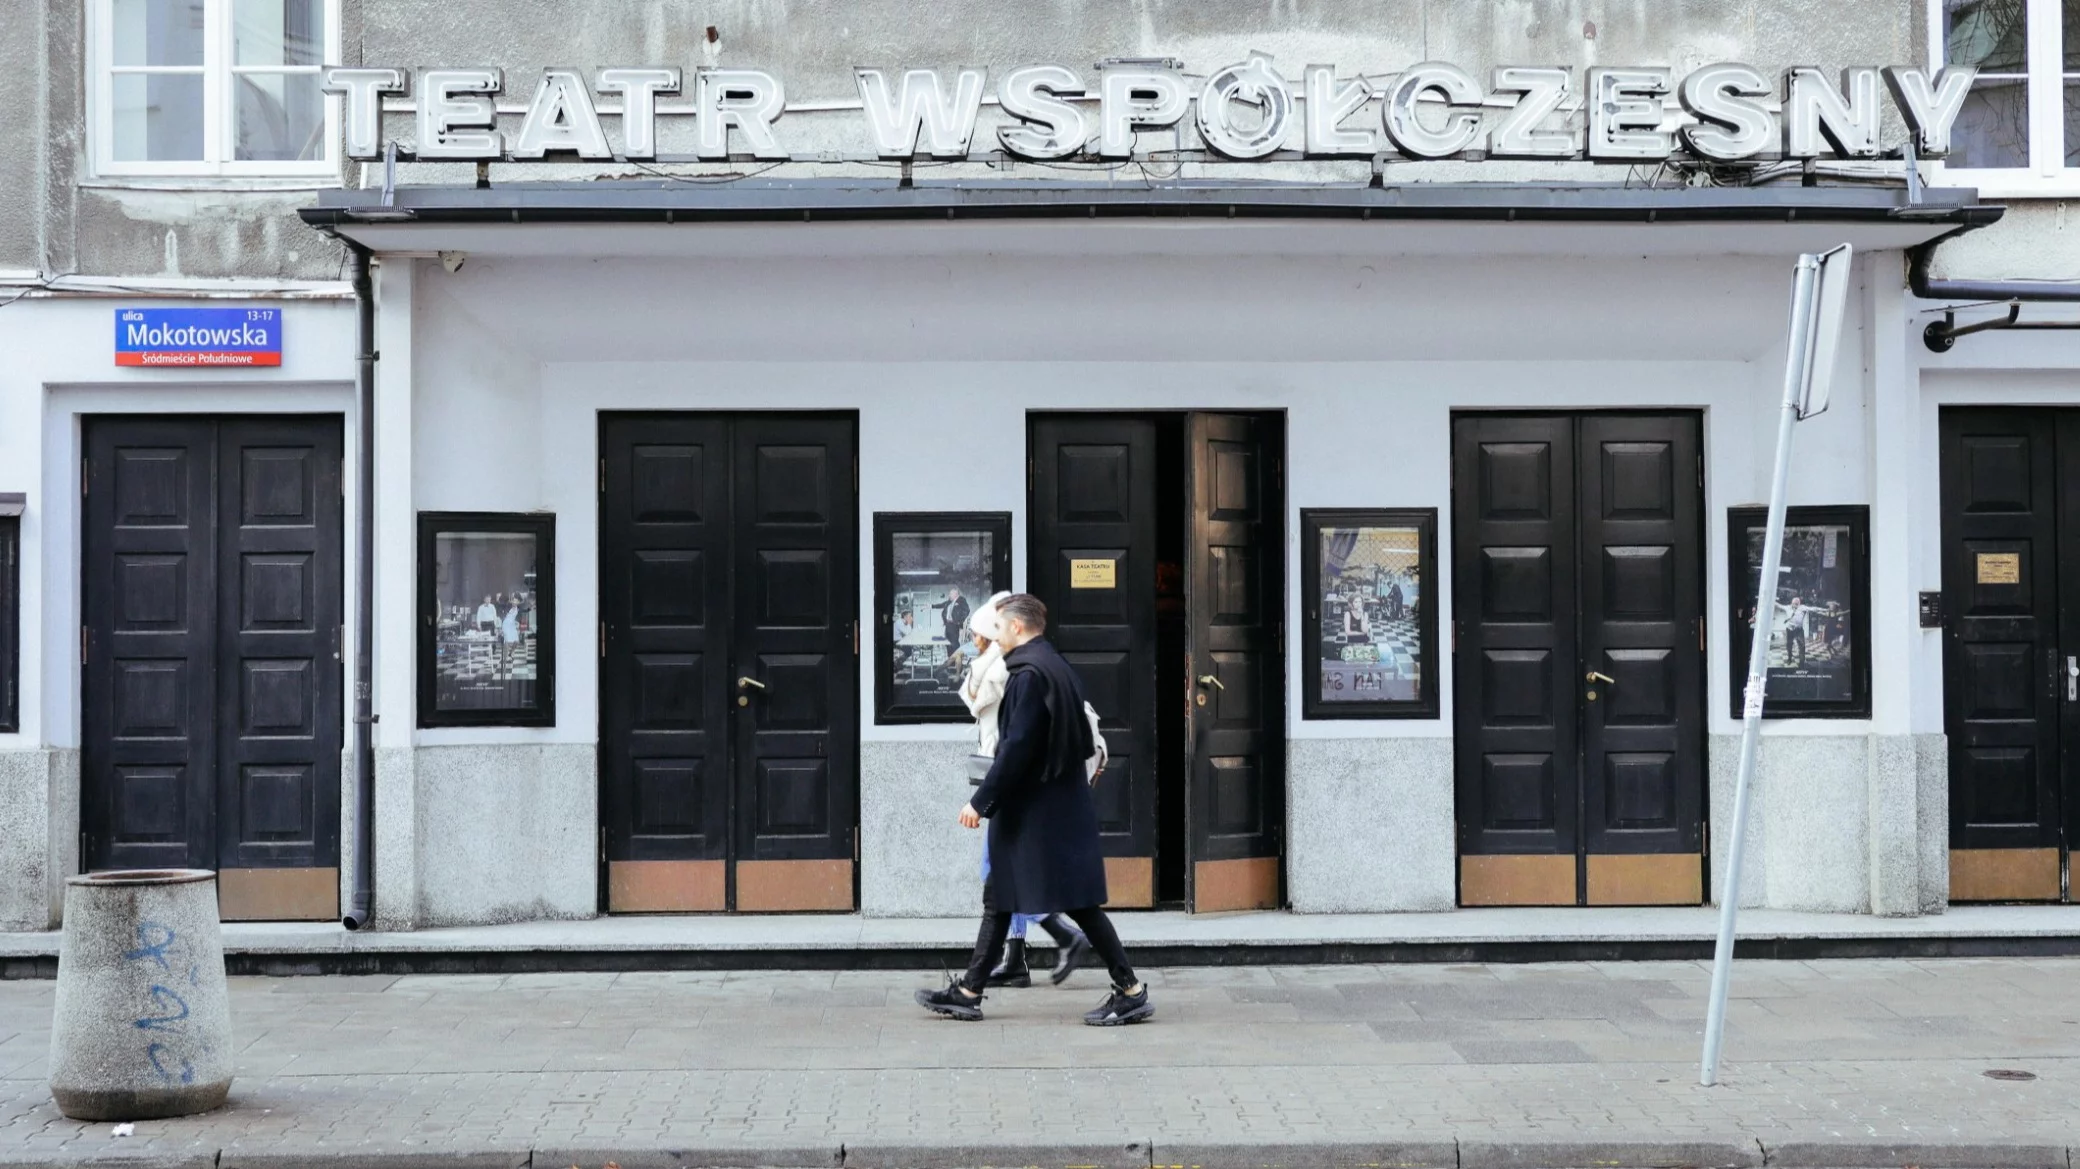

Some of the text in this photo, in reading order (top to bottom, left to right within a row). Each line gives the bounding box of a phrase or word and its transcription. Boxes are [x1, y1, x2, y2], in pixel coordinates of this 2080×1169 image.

[321, 56, 1980, 162] TEATR WSPÓŁCZESNY
[122, 311, 143, 321] ulica
[247, 310, 273, 321] 13-17
[127, 322, 268, 346] Mokotowska
[142, 352, 253, 364] Śródmieście Południowe
